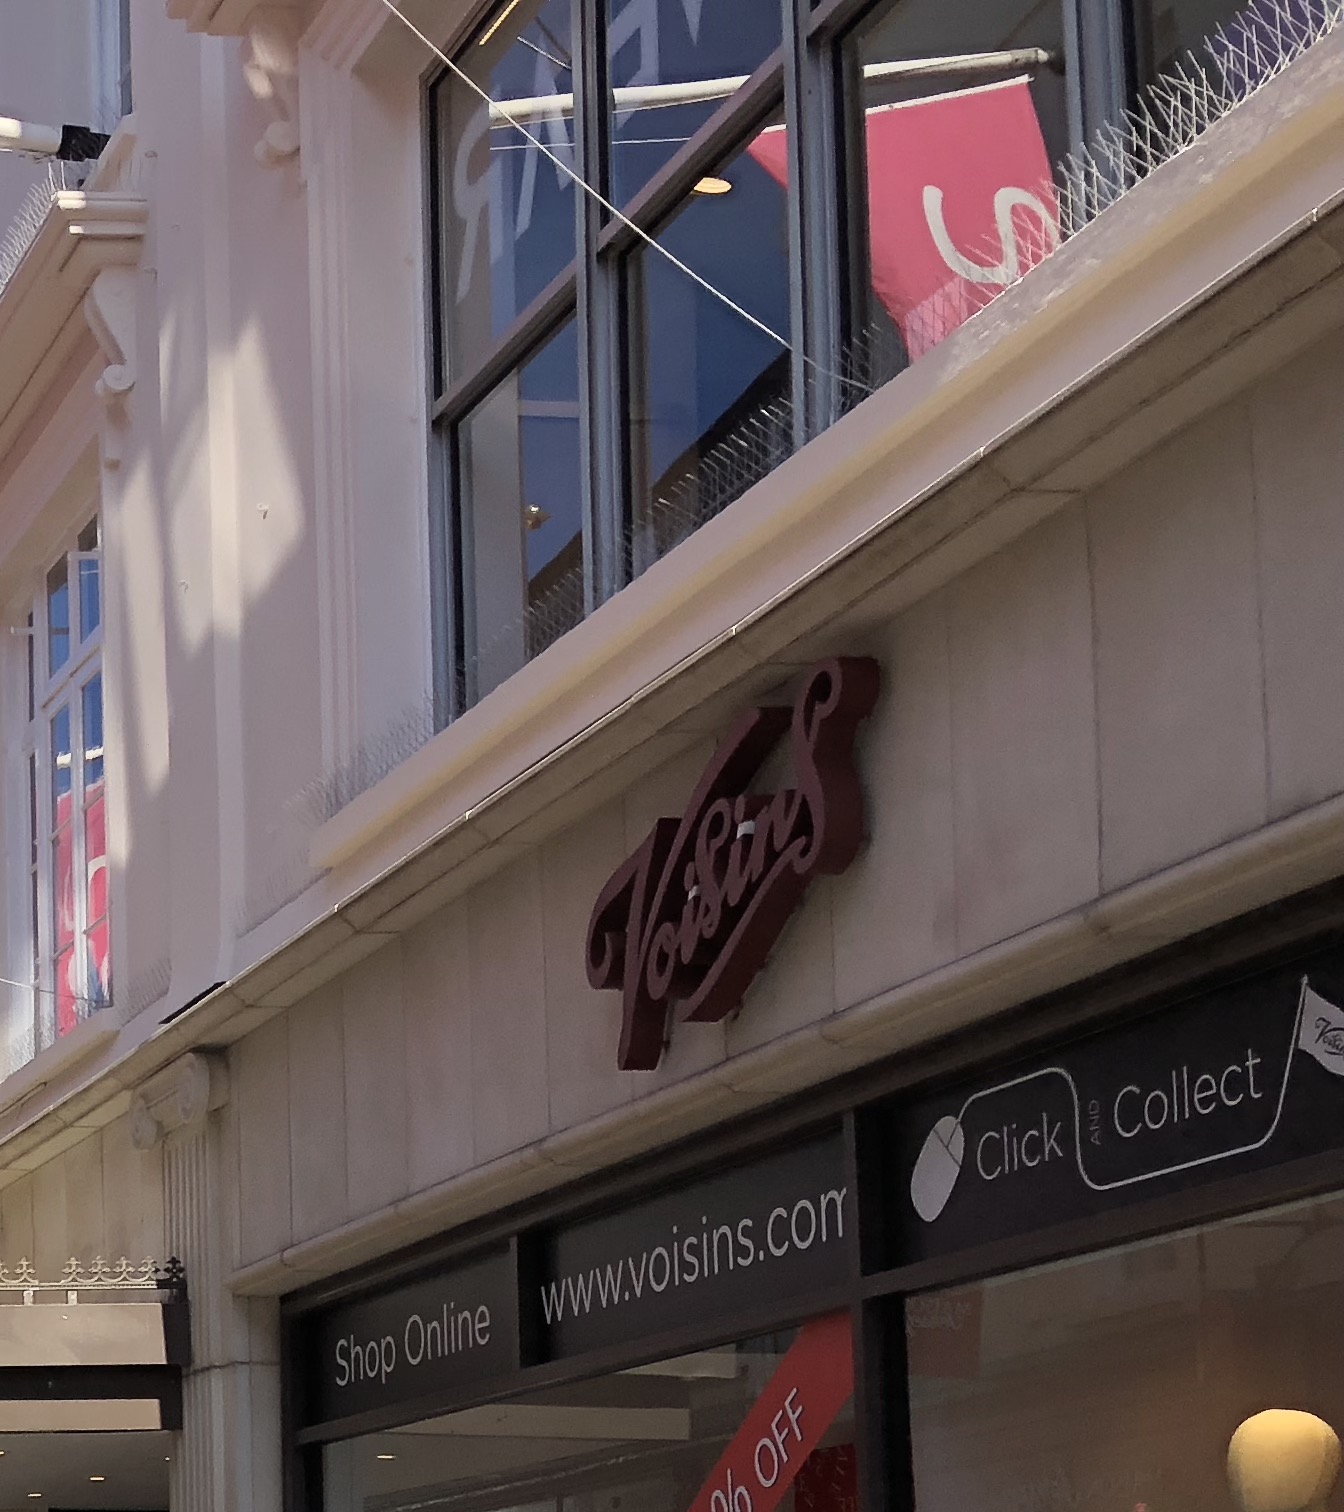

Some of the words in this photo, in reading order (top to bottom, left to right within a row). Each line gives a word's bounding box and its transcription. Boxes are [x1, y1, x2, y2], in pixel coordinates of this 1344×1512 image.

[585, 656, 880, 1070] Voisins
[976, 1112, 1064, 1181] Click
[1088, 1100, 1103, 1145] AND
[1114, 1048, 1263, 1138] Collect
[336, 1334, 396, 1387] Shop
[404, 1301, 491, 1366] Online
[754, 1387, 804, 1490] OFF
